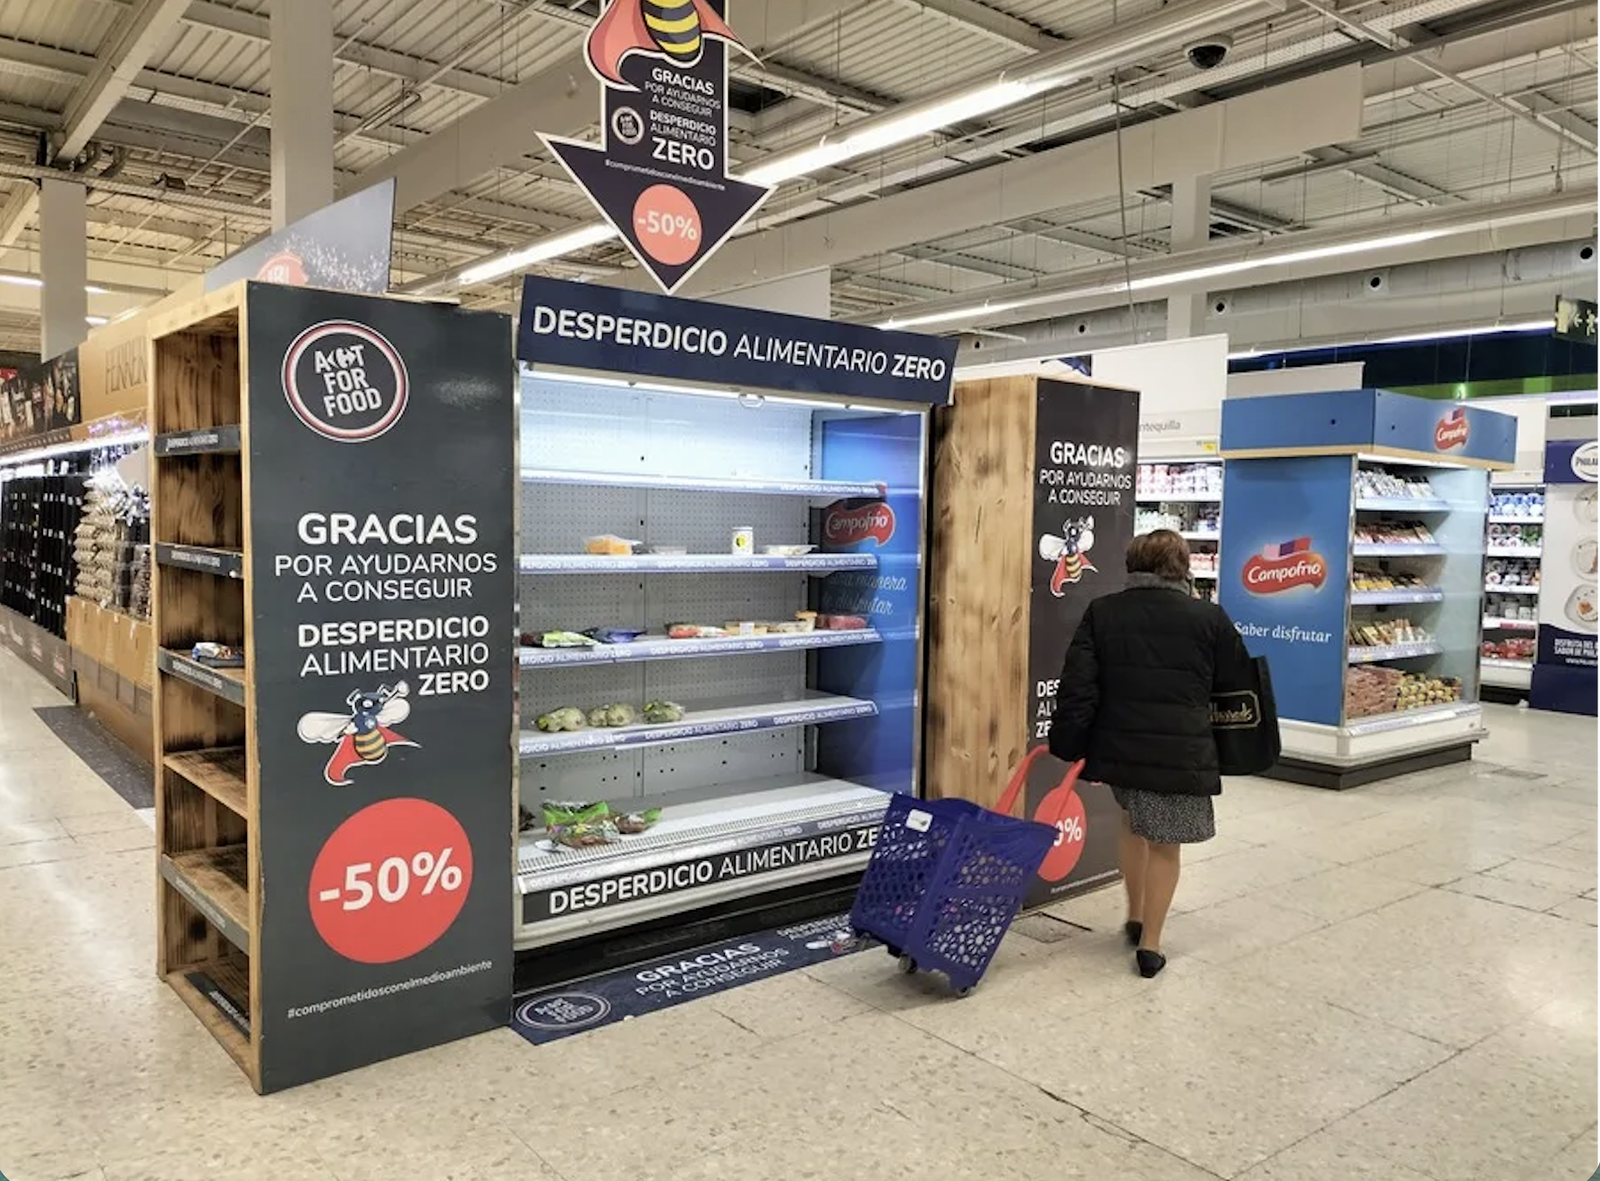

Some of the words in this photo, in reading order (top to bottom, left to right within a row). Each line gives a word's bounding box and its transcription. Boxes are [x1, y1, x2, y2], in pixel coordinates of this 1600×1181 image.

[645, 81, 664, 94] POR
[666, 88, 722, 110] AYUDARNOS
[652, 67, 714, 96] GRACIAS
[661, 96, 713, 117] CONSEGUIR
[650, 110, 716, 135] DESPERDICIO
[650, 123, 716, 147] ALIMENTARIO
[652, 137, 714, 170] ZERO
[637, 209, 698, 242] -50%
[532, 305, 727, 356] DESPERDICIO
[734, 333, 887, 375] ALIMENTARIO
[891, 353, 946, 382] ZERO
[323, 367, 370, 395] FOR
[323, 388, 382, 418] FOOD
[1139, 420, 1181, 433] ntequilla
[1050, 441, 1125, 468] GRACIAS
[1040, 469, 1064, 486] POR
[1066, 471, 1132, 490] AYUDARNOS
[1048, 488, 1057, 504] A
[1059, 488, 1121, 506] CONSEGUIR
[297, 512, 478, 545] GRACIAS
[275, 554, 333, 577] POR
[340, 552, 497, 575] AYUDARNOS
[297, 582, 318, 603] A
[325, 578, 473, 602] CONSEGUIR
[298, 616, 490, 647] DESPERDICIO
[1272, 625, 1332, 643] disfrutar
[300, 642, 489, 678] ALIMENTARIO
[418, 670, 490, 696] ZERO
[320, 847, 463, 911] -50%
[549, 860, 713, 914] DESPERDICIO
[718, 833, 852, 879] ALIMENTARIO
[856, 826, 878, 849] ZE
[636, 942, 761, 982] GRACIAS
[636, 979, 680, 996] POR
[682, 948, 790, 983] AYUDARNOS
[287, 959, 493, 1019] #comprometidosconelmedioambiente
[665, 990, 682, 998] A
[682, 959, 786, 992] CONSEGUIR
